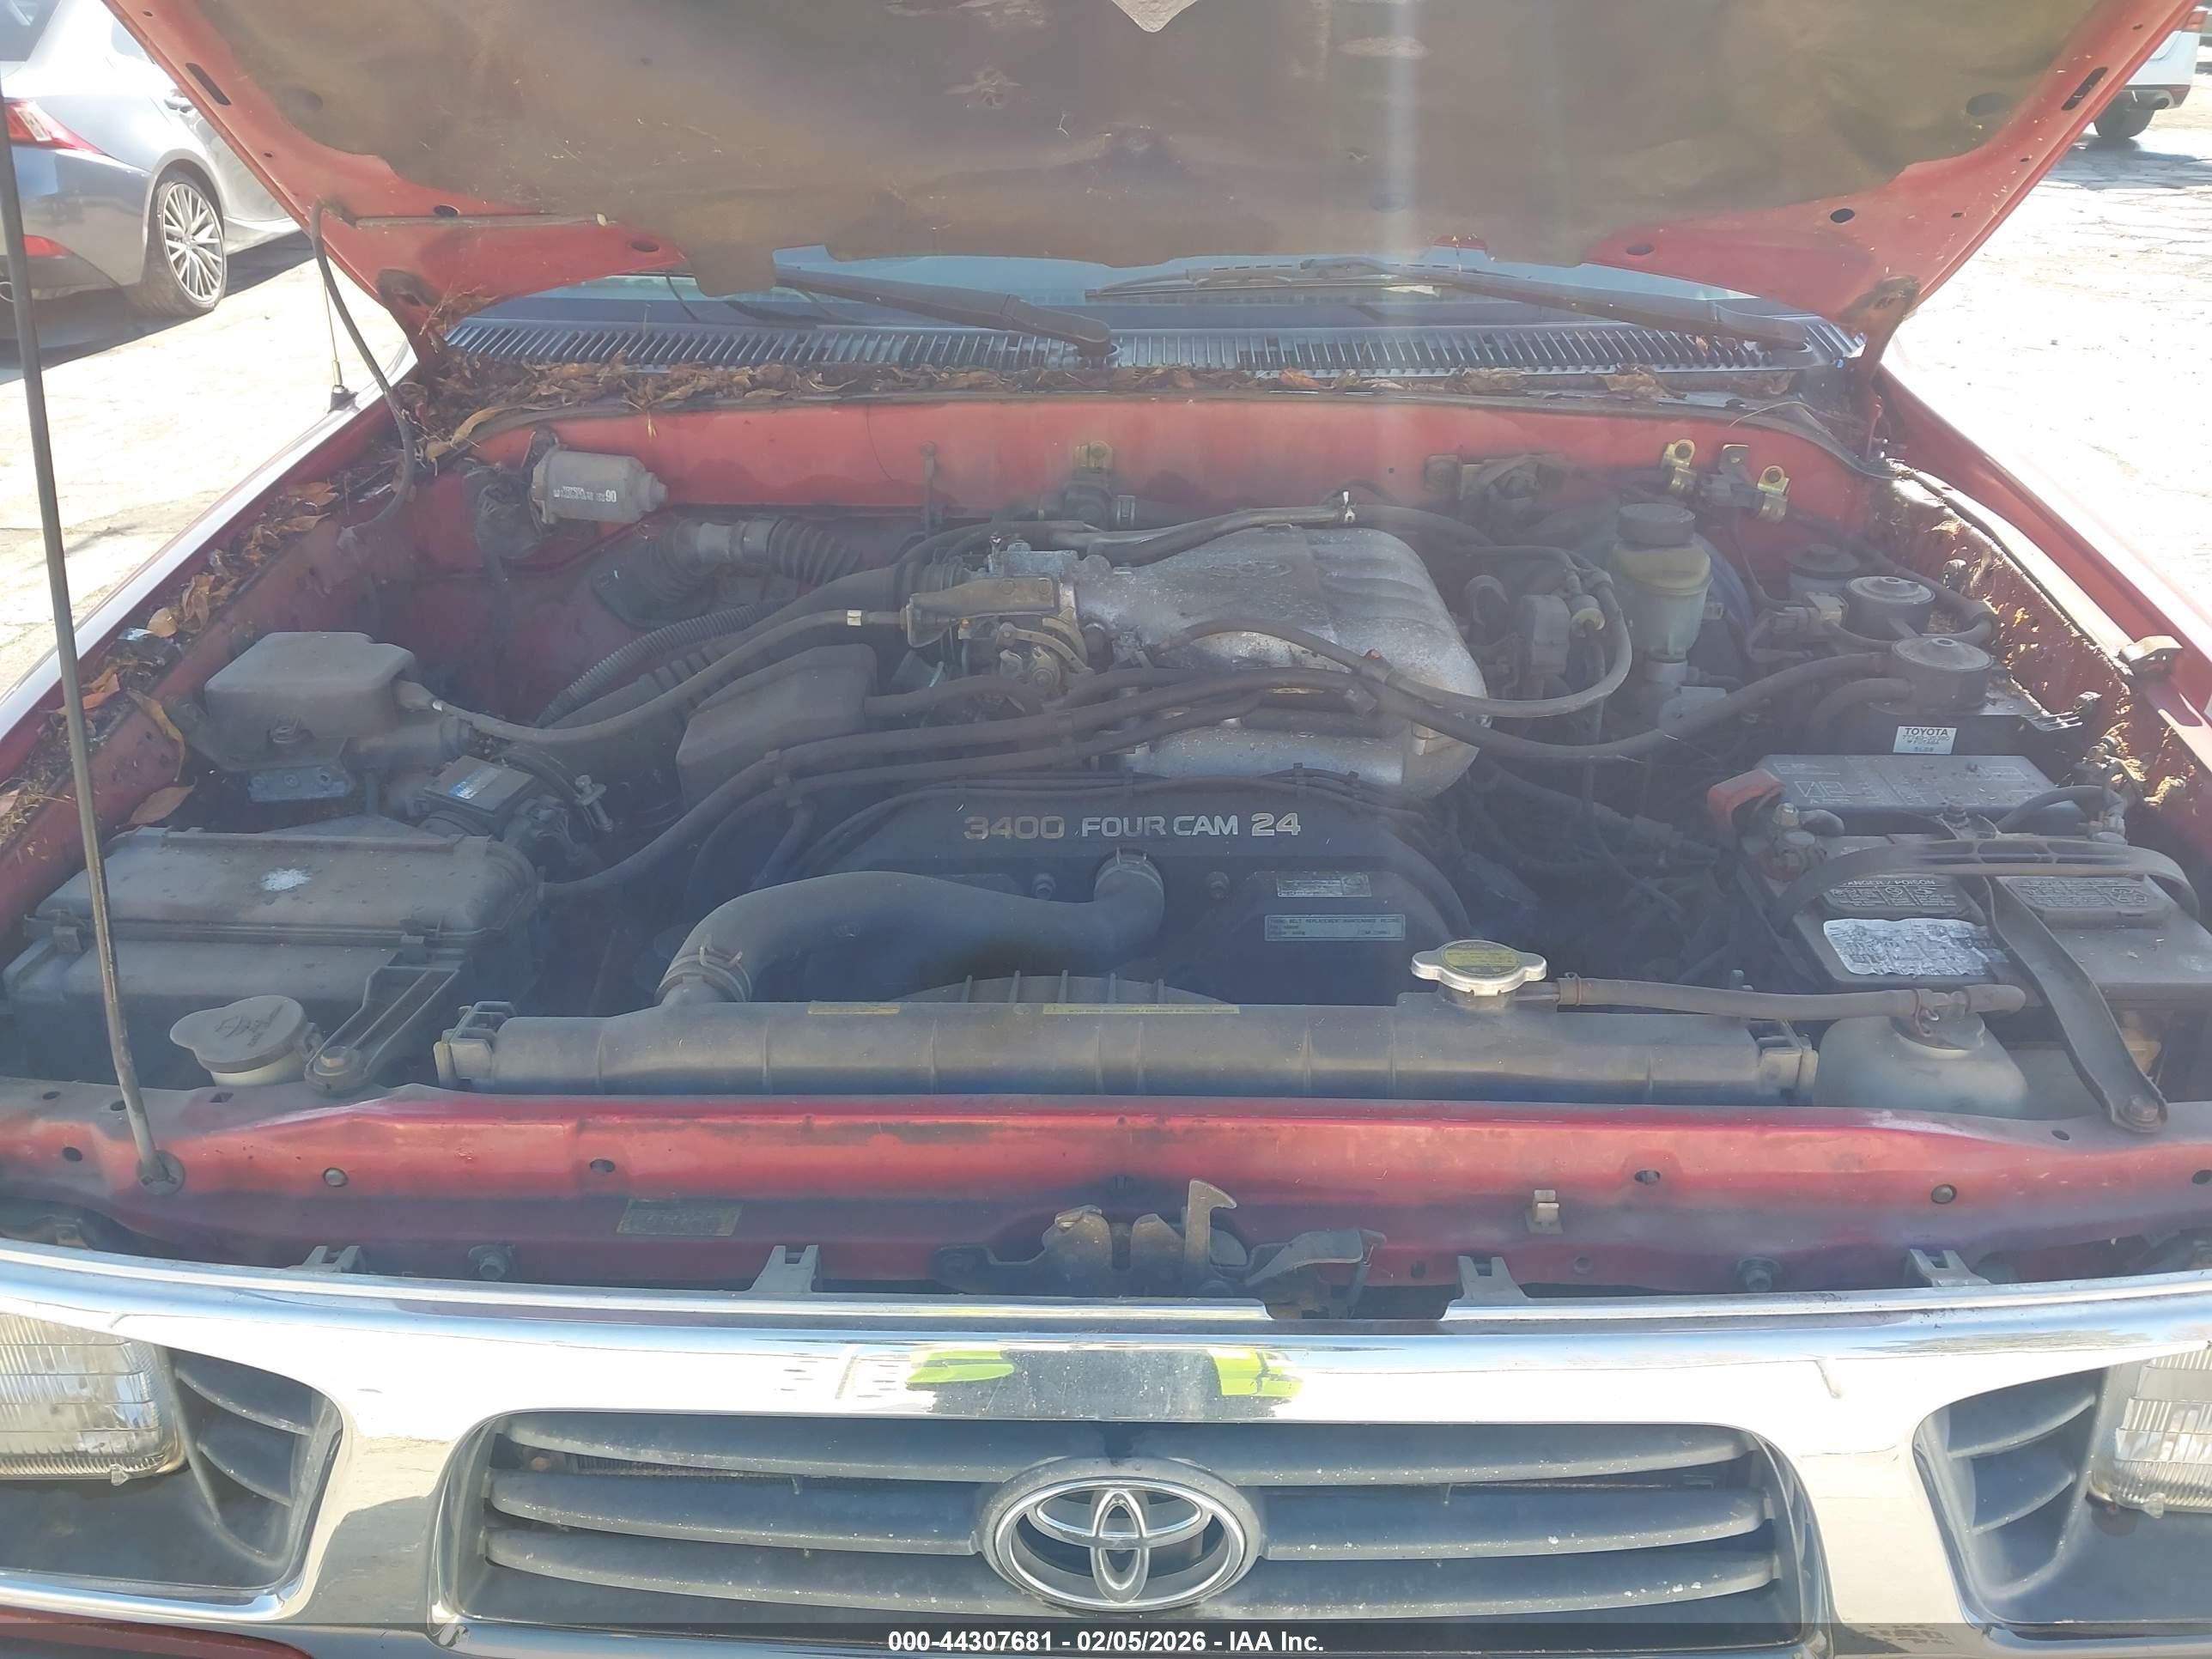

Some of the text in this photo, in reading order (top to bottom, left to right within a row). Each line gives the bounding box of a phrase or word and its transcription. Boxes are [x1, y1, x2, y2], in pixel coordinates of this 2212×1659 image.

[1905, 727, 1948, 736] TOYOTA
[963, 812, 1301, 839] 3400 FOUR CAM 24
